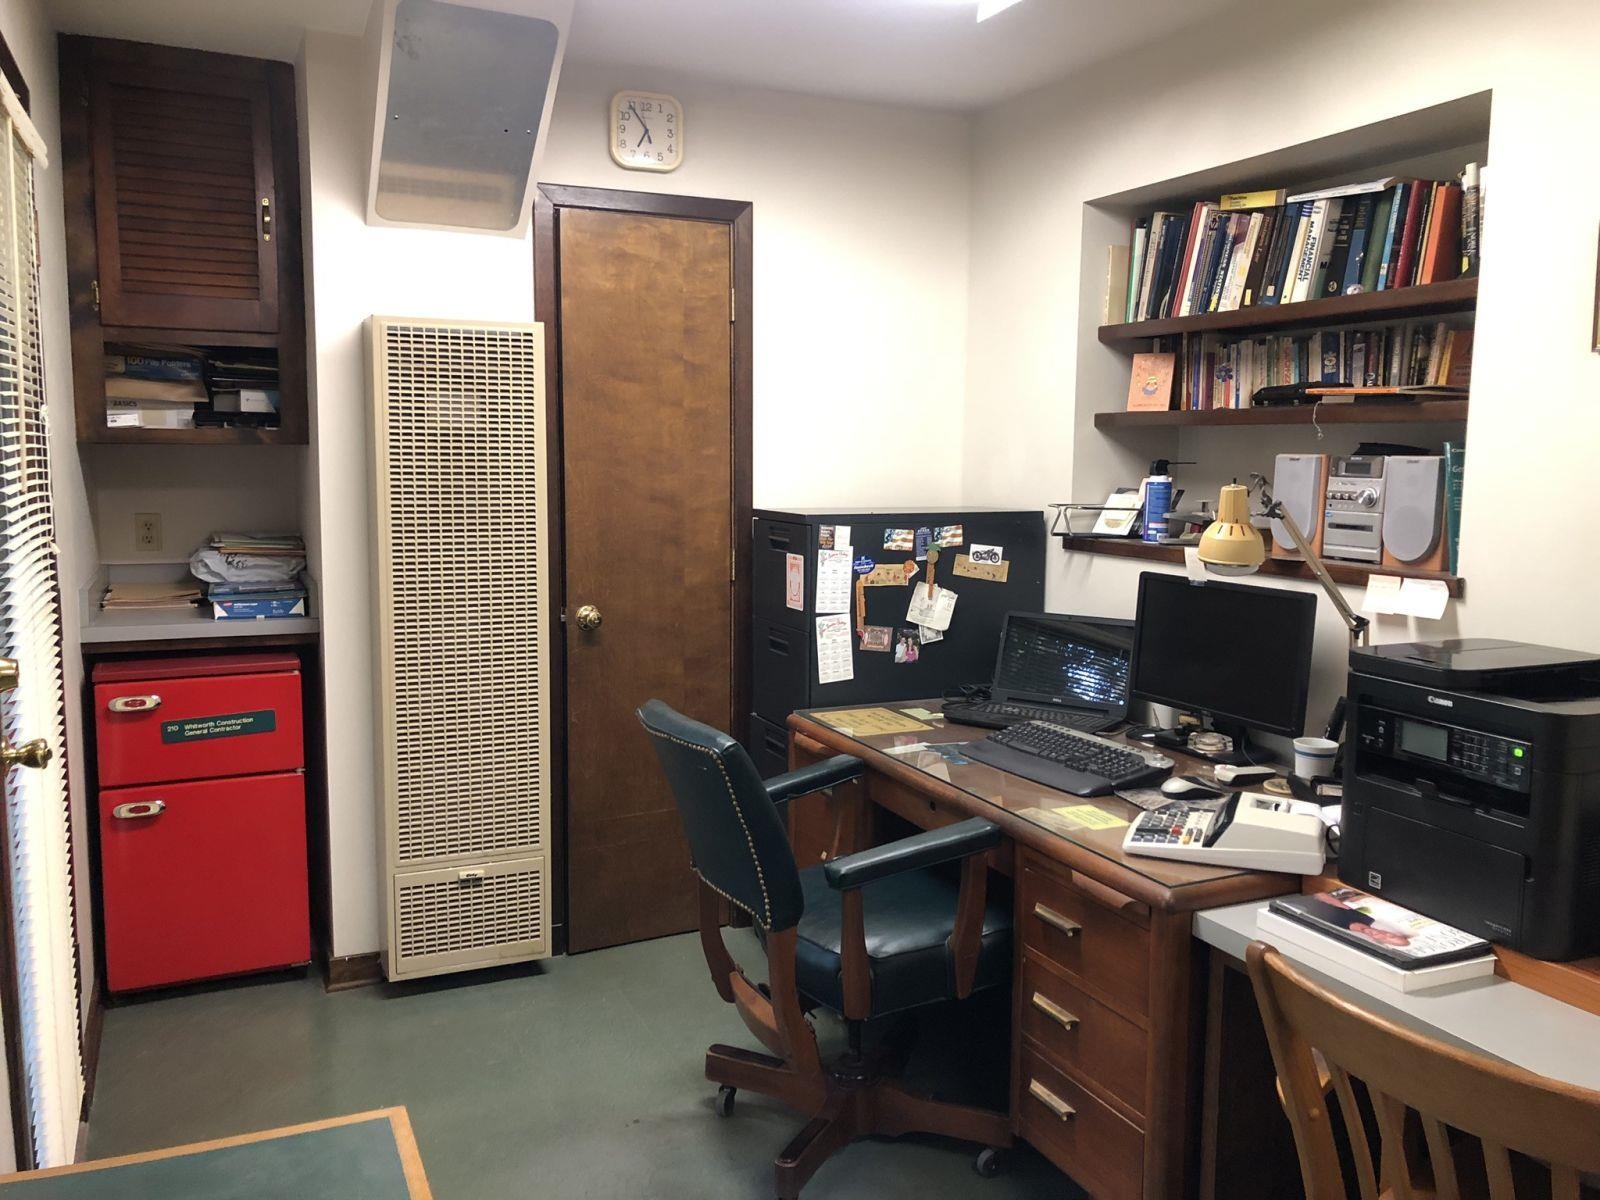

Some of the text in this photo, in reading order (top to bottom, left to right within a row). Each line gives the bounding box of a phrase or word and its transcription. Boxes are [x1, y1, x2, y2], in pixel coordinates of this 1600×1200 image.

[641, 102, 652, 112] 12
[658, 103, 663, 113] 1
[619, 111, 631, 121] 10
[666, 113, 673, 123] 2
[619, 124, 626, 133] 9
[667, 129, 674, 138] 3
[620, 140, 626, 148] 8
[667, 144, 673, 153] 4
[630, 149, 636, 158] 7
[657, 152, 664, 161] 5
[1298, 221, 1315, 281] MANAGEMENT
[1303, 236, 1317, 280] FINANCIAL
[1427, 696, 1453, 707] Canon
[184, 721, 215, 730] Whitworth
[216, 717, 254, 726] Construction
[209, 725, 241, 733] Contractor
